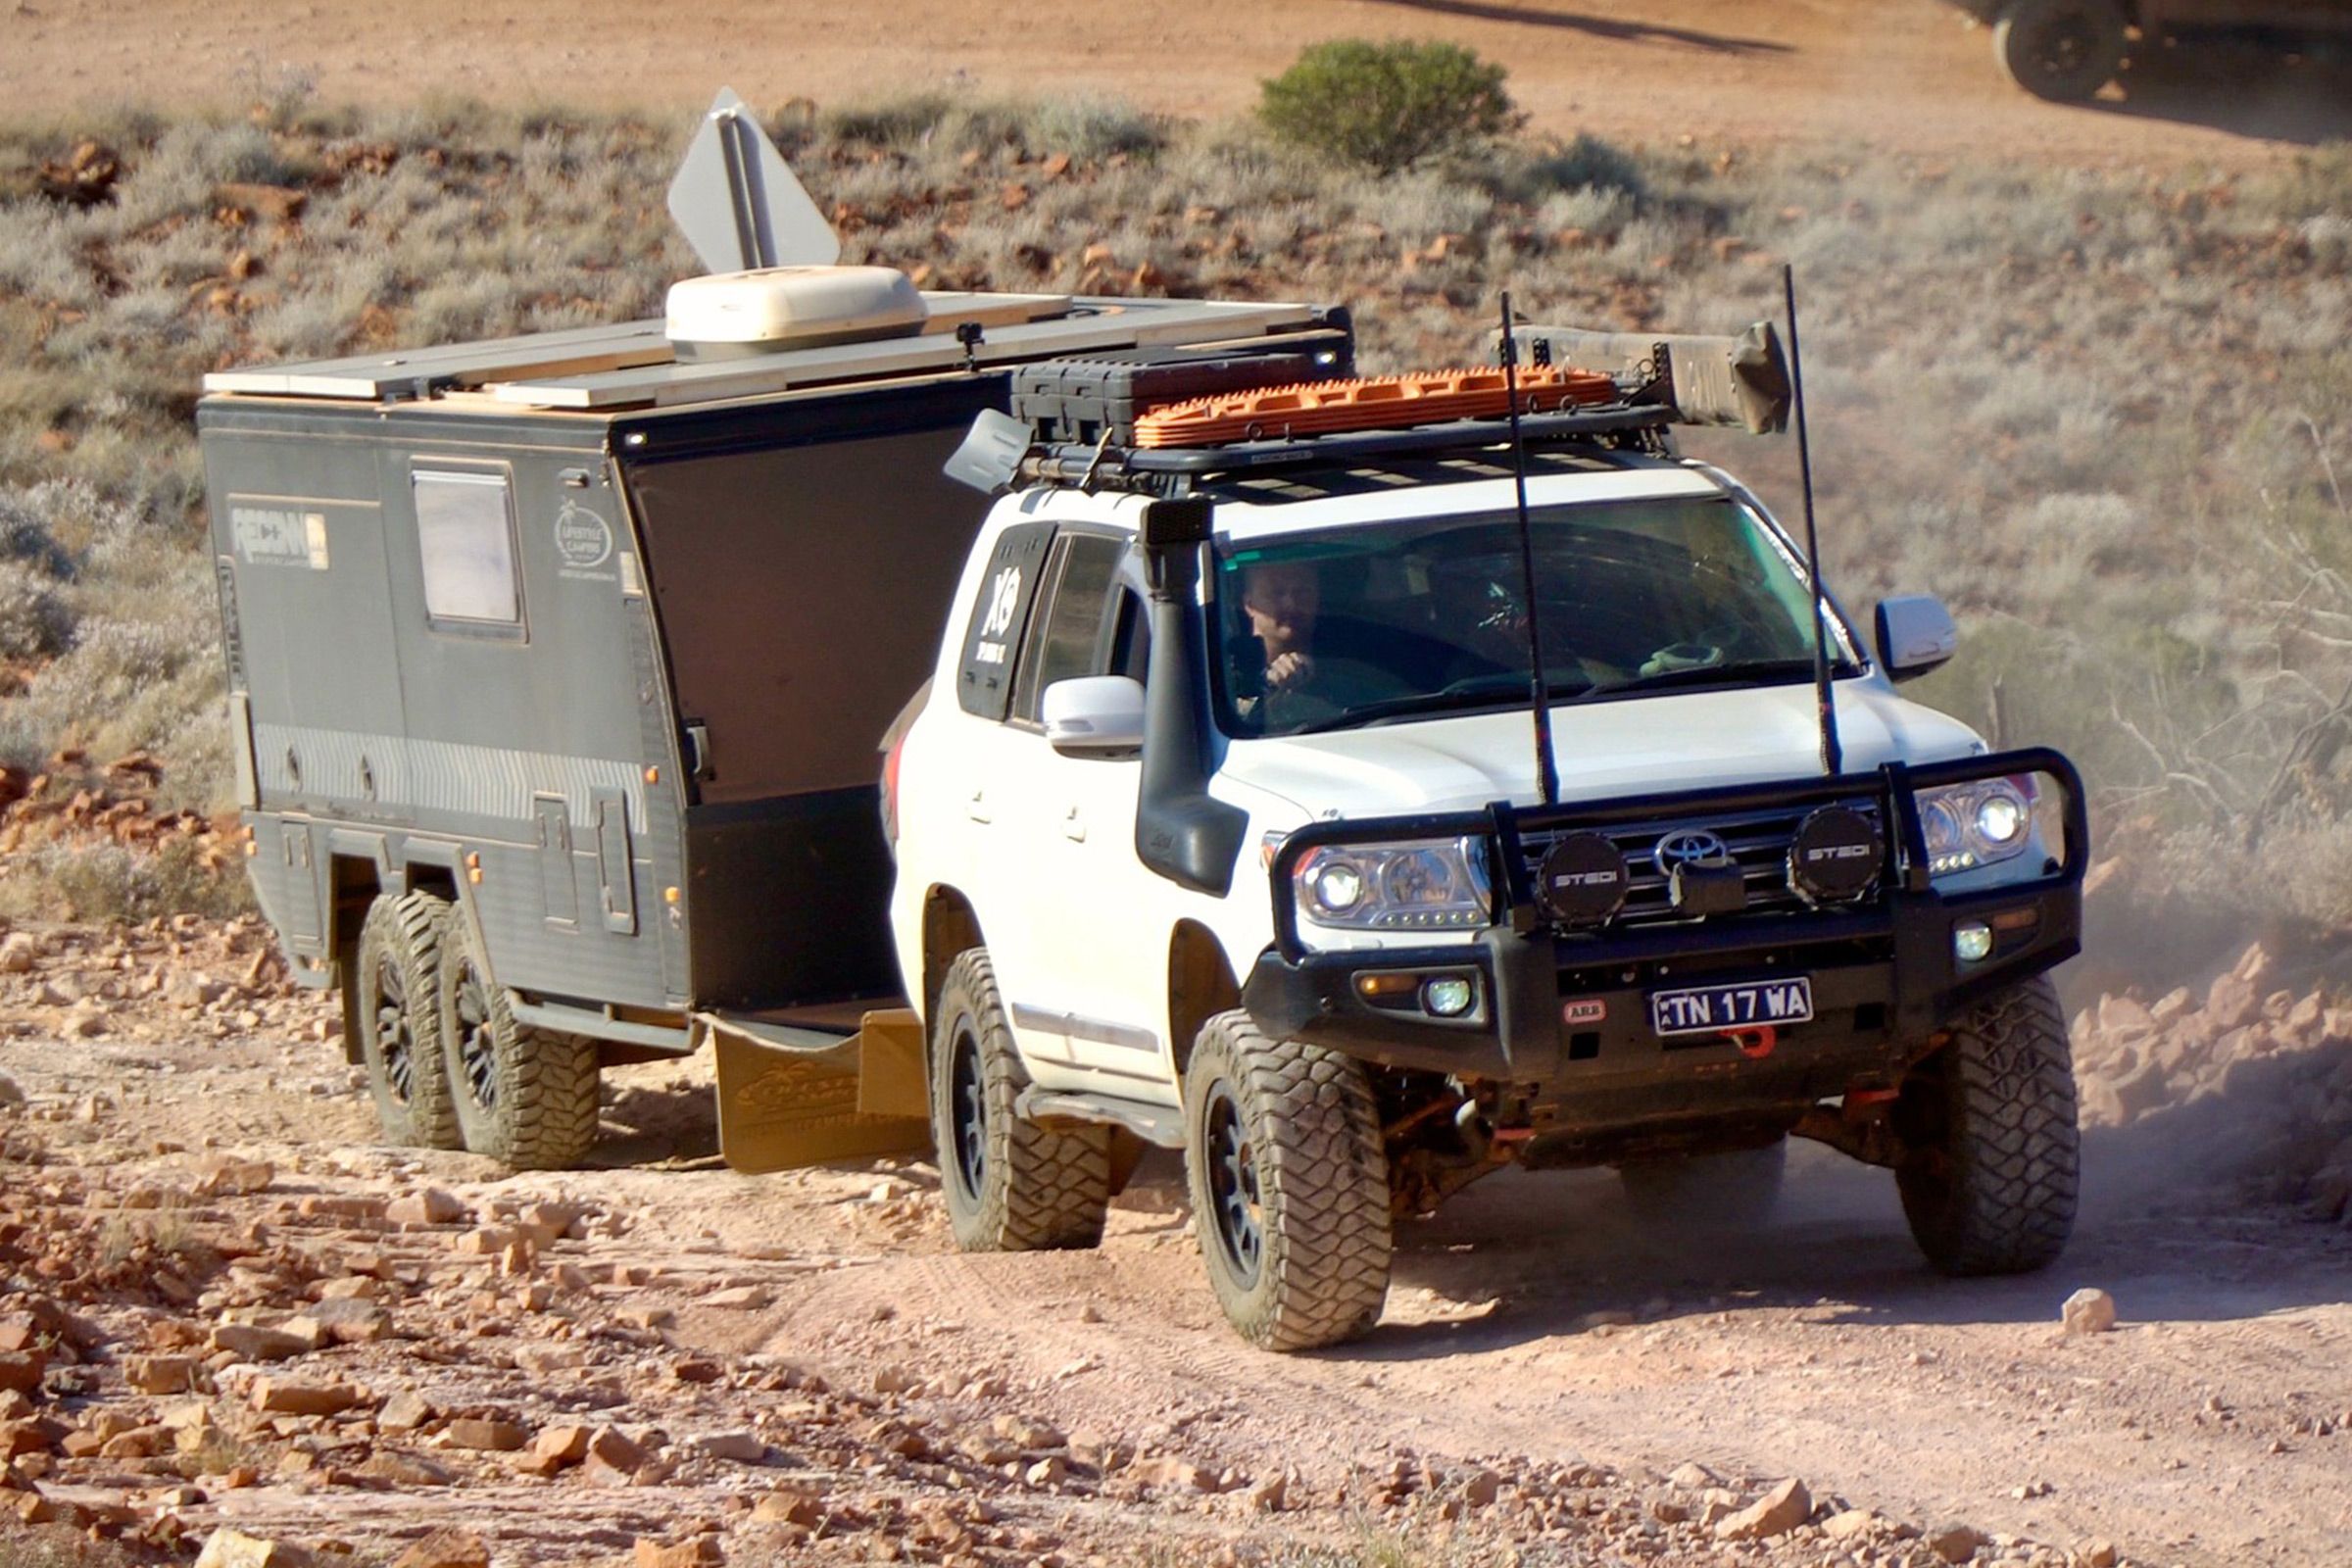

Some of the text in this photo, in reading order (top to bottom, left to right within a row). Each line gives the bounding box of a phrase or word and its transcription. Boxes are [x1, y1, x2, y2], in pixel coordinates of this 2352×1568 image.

[1808, 845, 1870, 860] STEDI
[1555, 872, 1617, 887] STEDI
[1570, 1004, 1601, 1019] ARB
[1670, 986, 1807, 1026] TN 17 WA
